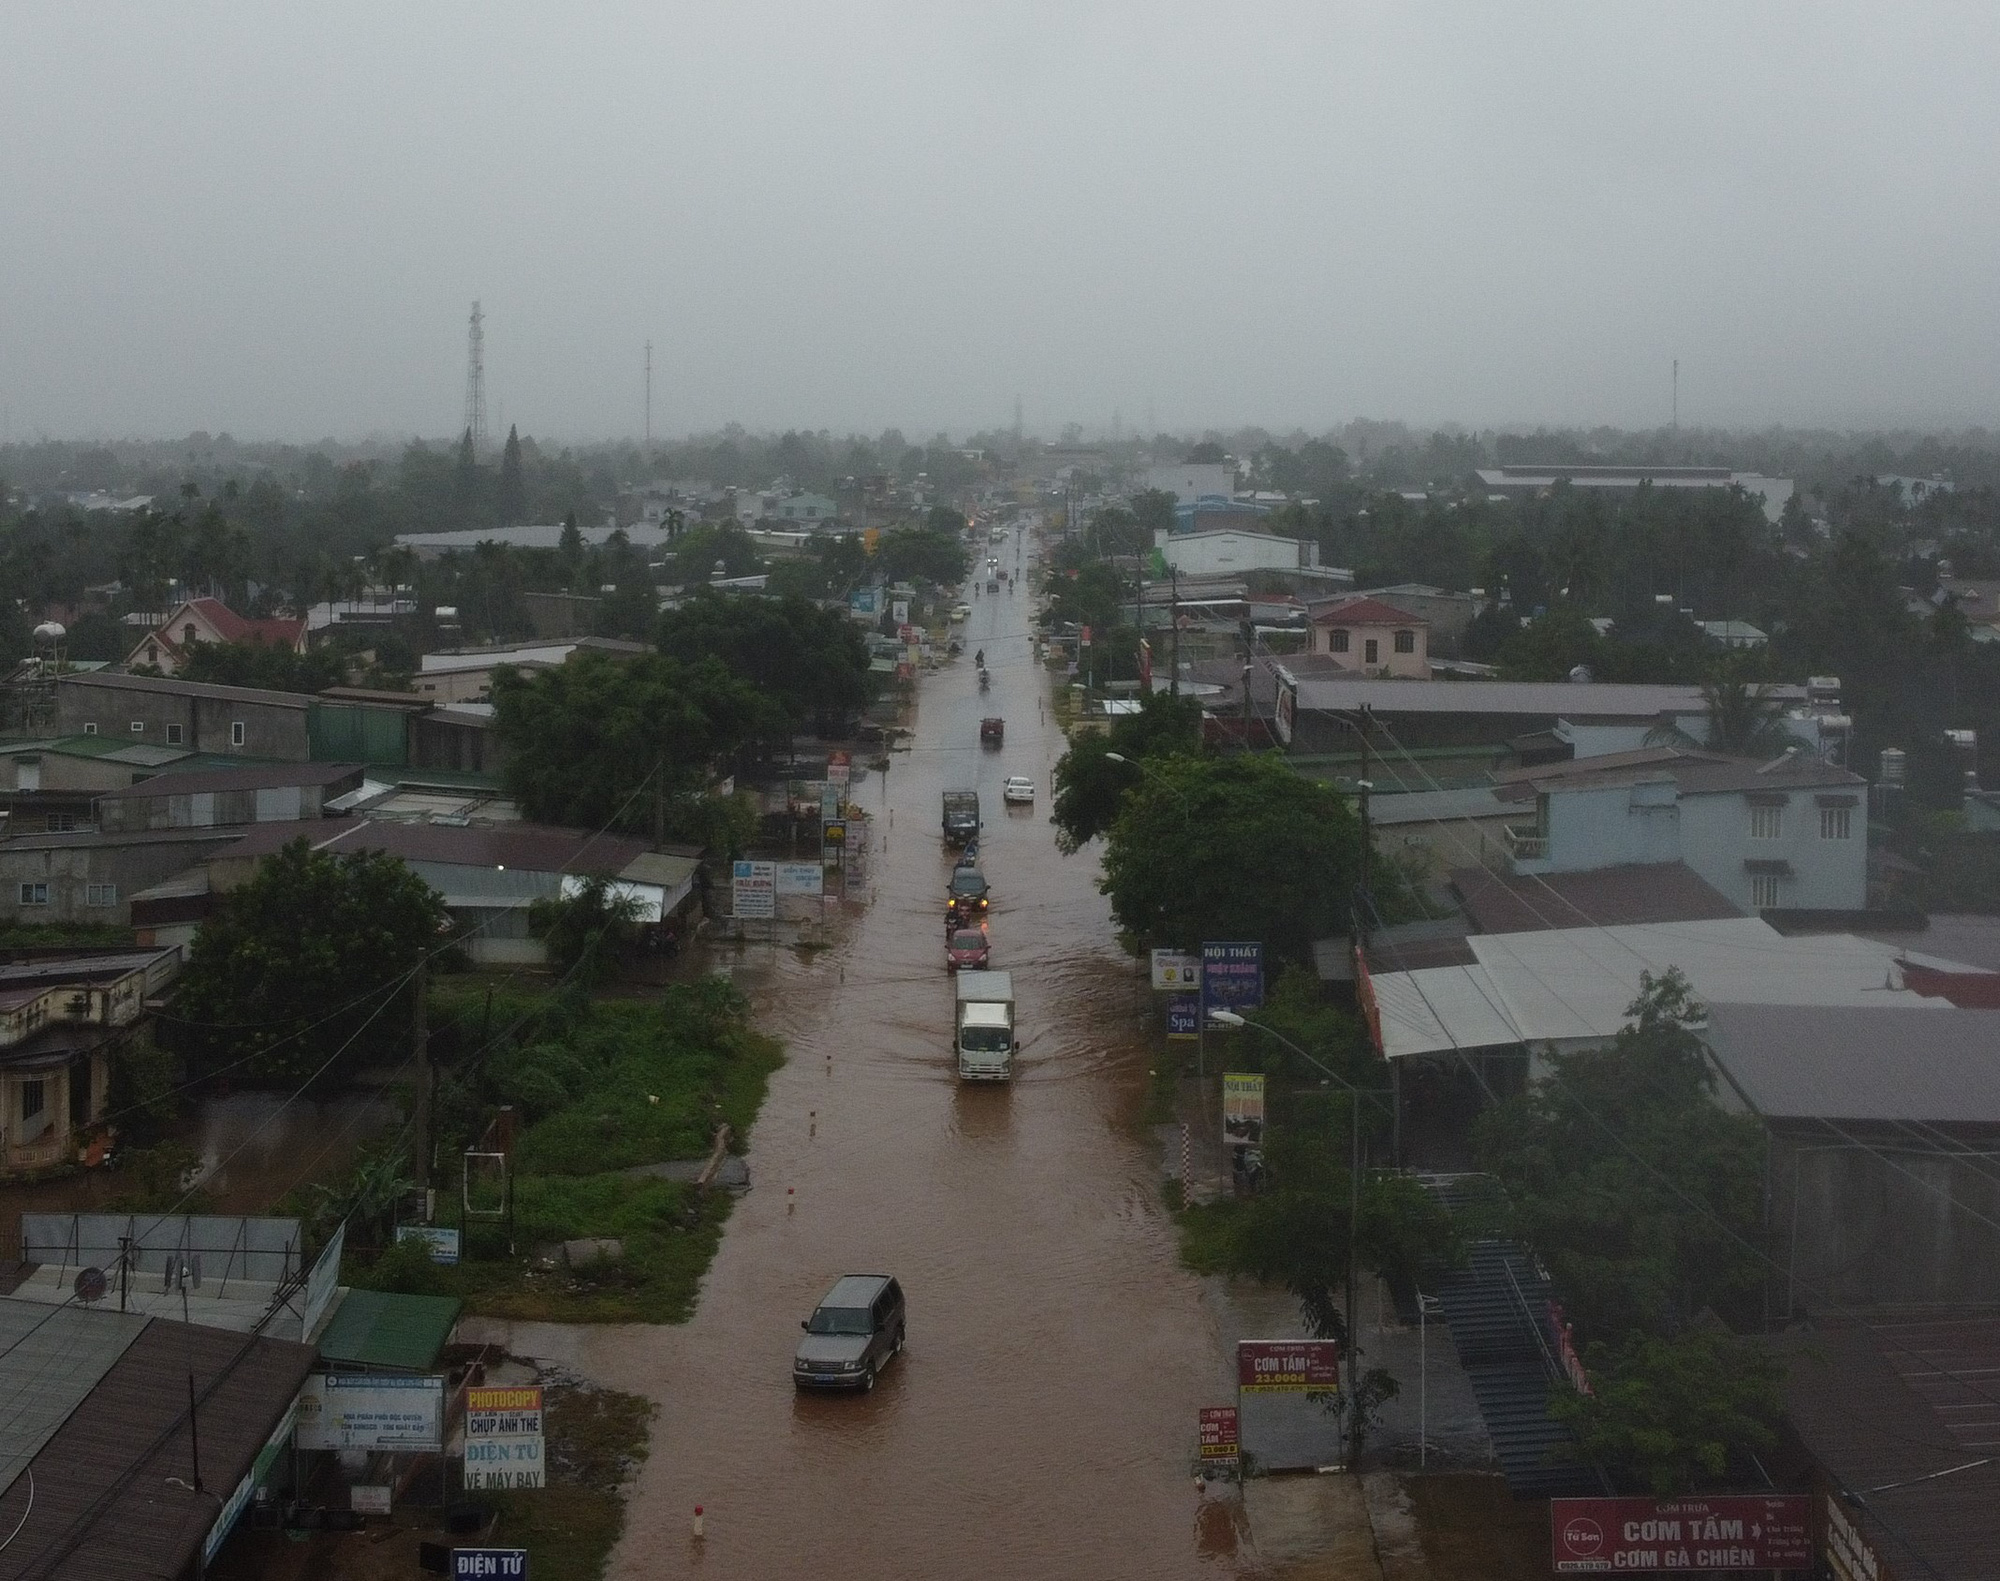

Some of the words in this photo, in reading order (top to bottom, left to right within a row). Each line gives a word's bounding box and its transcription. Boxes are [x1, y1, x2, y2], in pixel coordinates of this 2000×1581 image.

[1171, 1014, 1195, 1031] Spa
[1254, 1356, 1279, 1372] CƠM
[1282, 1352, 1305, 1371] TẤM
[469, 1391, 538, 1408] PHOTOCOPY
[471, 1418, 496, 1435] CHỤP
[1200, 1423, 1219, 1432] CƠM
[467, 1440, 510, 1464] ĐIỆN
[466, 1468, 481, 1489] VÉ
[486, 1468, 512, 1489] MÁY
[516, 1471, 540, 1488] BAY
[1623, 1519, 1681, 1542] CƠM
[1688, 1512, 1743, 1540] TẤM
[457, 1553, 496, 1578] ĐIỆN
[500, 1552, 524, 1575] TỬ
[1614, 1549, 1658, 1568] CƠM
[1664, 1546, 1691, 1567] GÀ
[1696, 1545, 1755, 1566] CHIÊN
